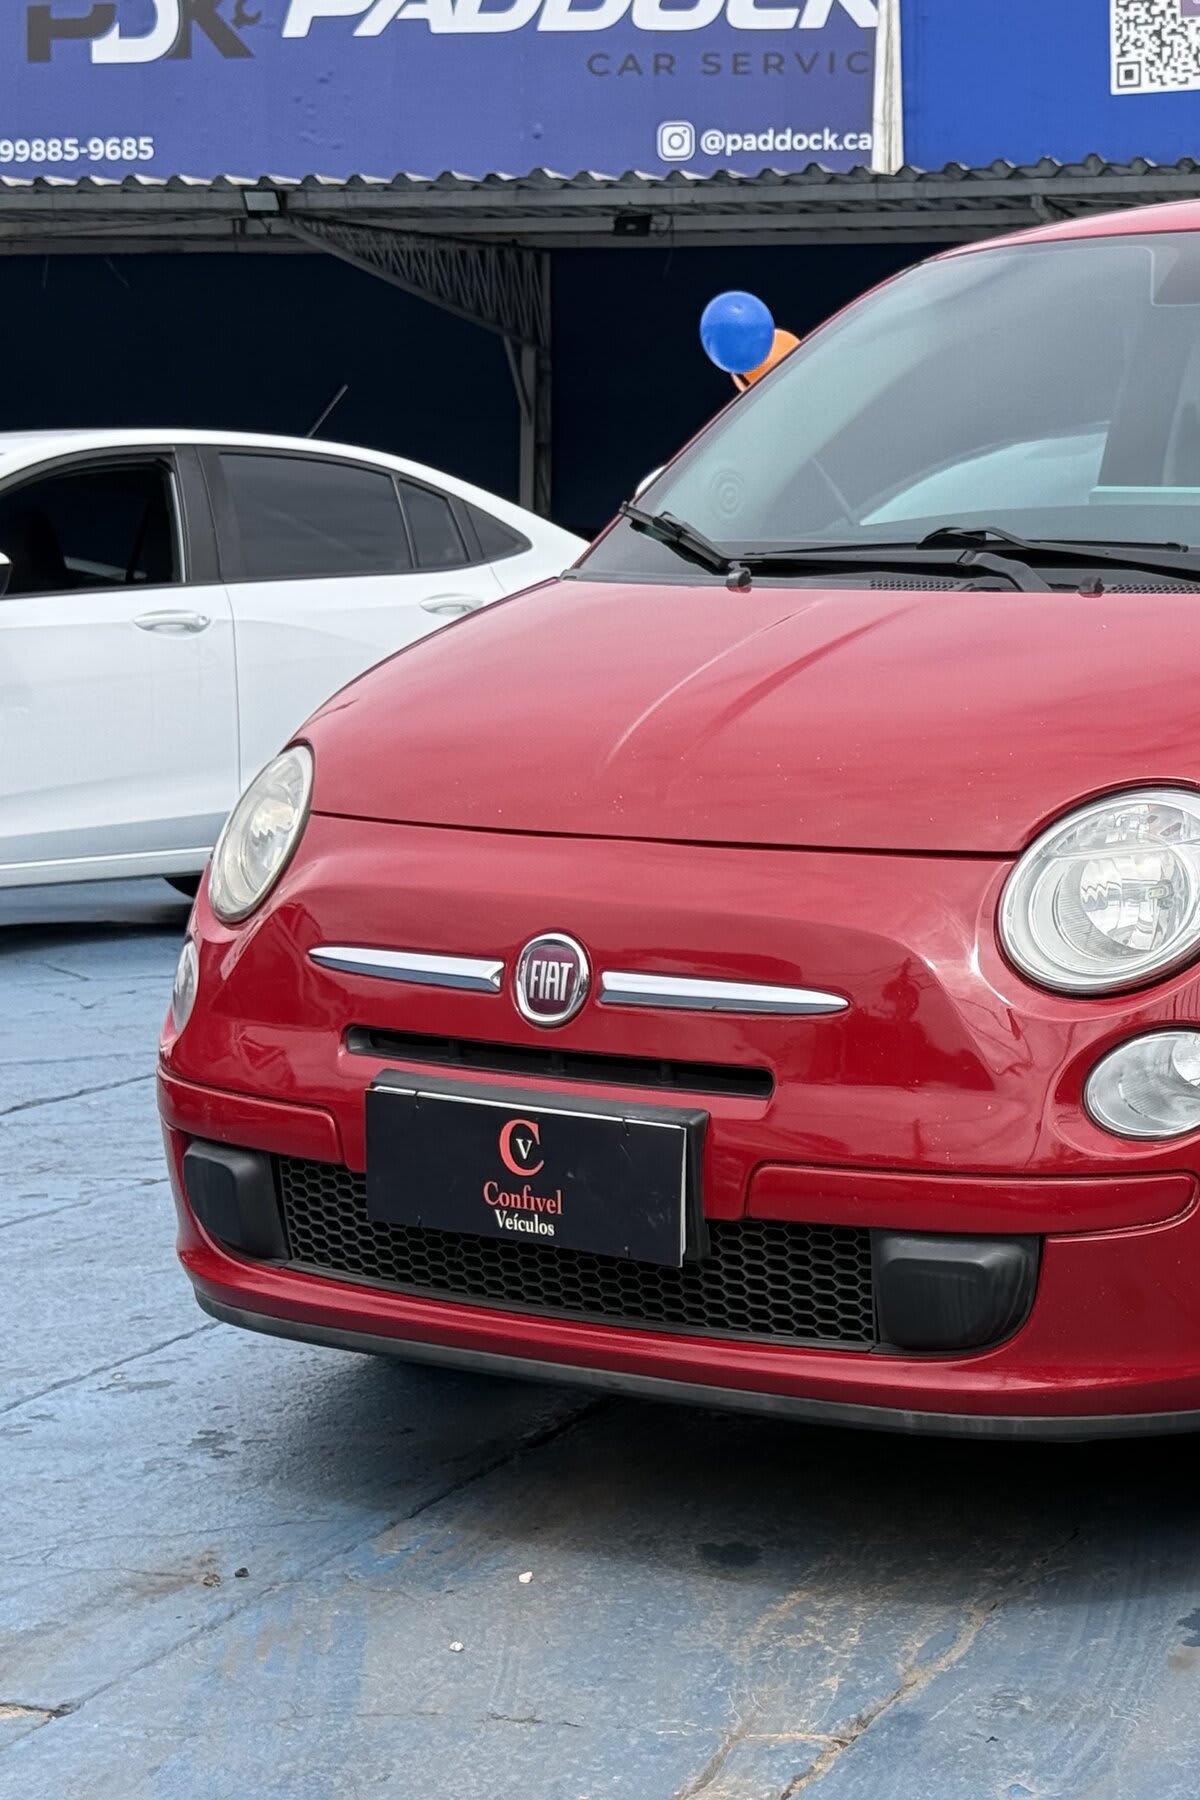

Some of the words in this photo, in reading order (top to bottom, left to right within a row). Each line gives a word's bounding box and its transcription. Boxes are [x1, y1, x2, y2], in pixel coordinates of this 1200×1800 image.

[587, 53, 676, 76] CAR
[701, 51, 872, 75] SERVIC
[0, 136, 155, 162] 99885-9685
[701, 127, 873, 156] @paddock.ca
[529, 959, 574, 1001] FIAT
[483, 1181, 563, 1215] Confivel
[494, 1209, 555, 1237] Veículos
